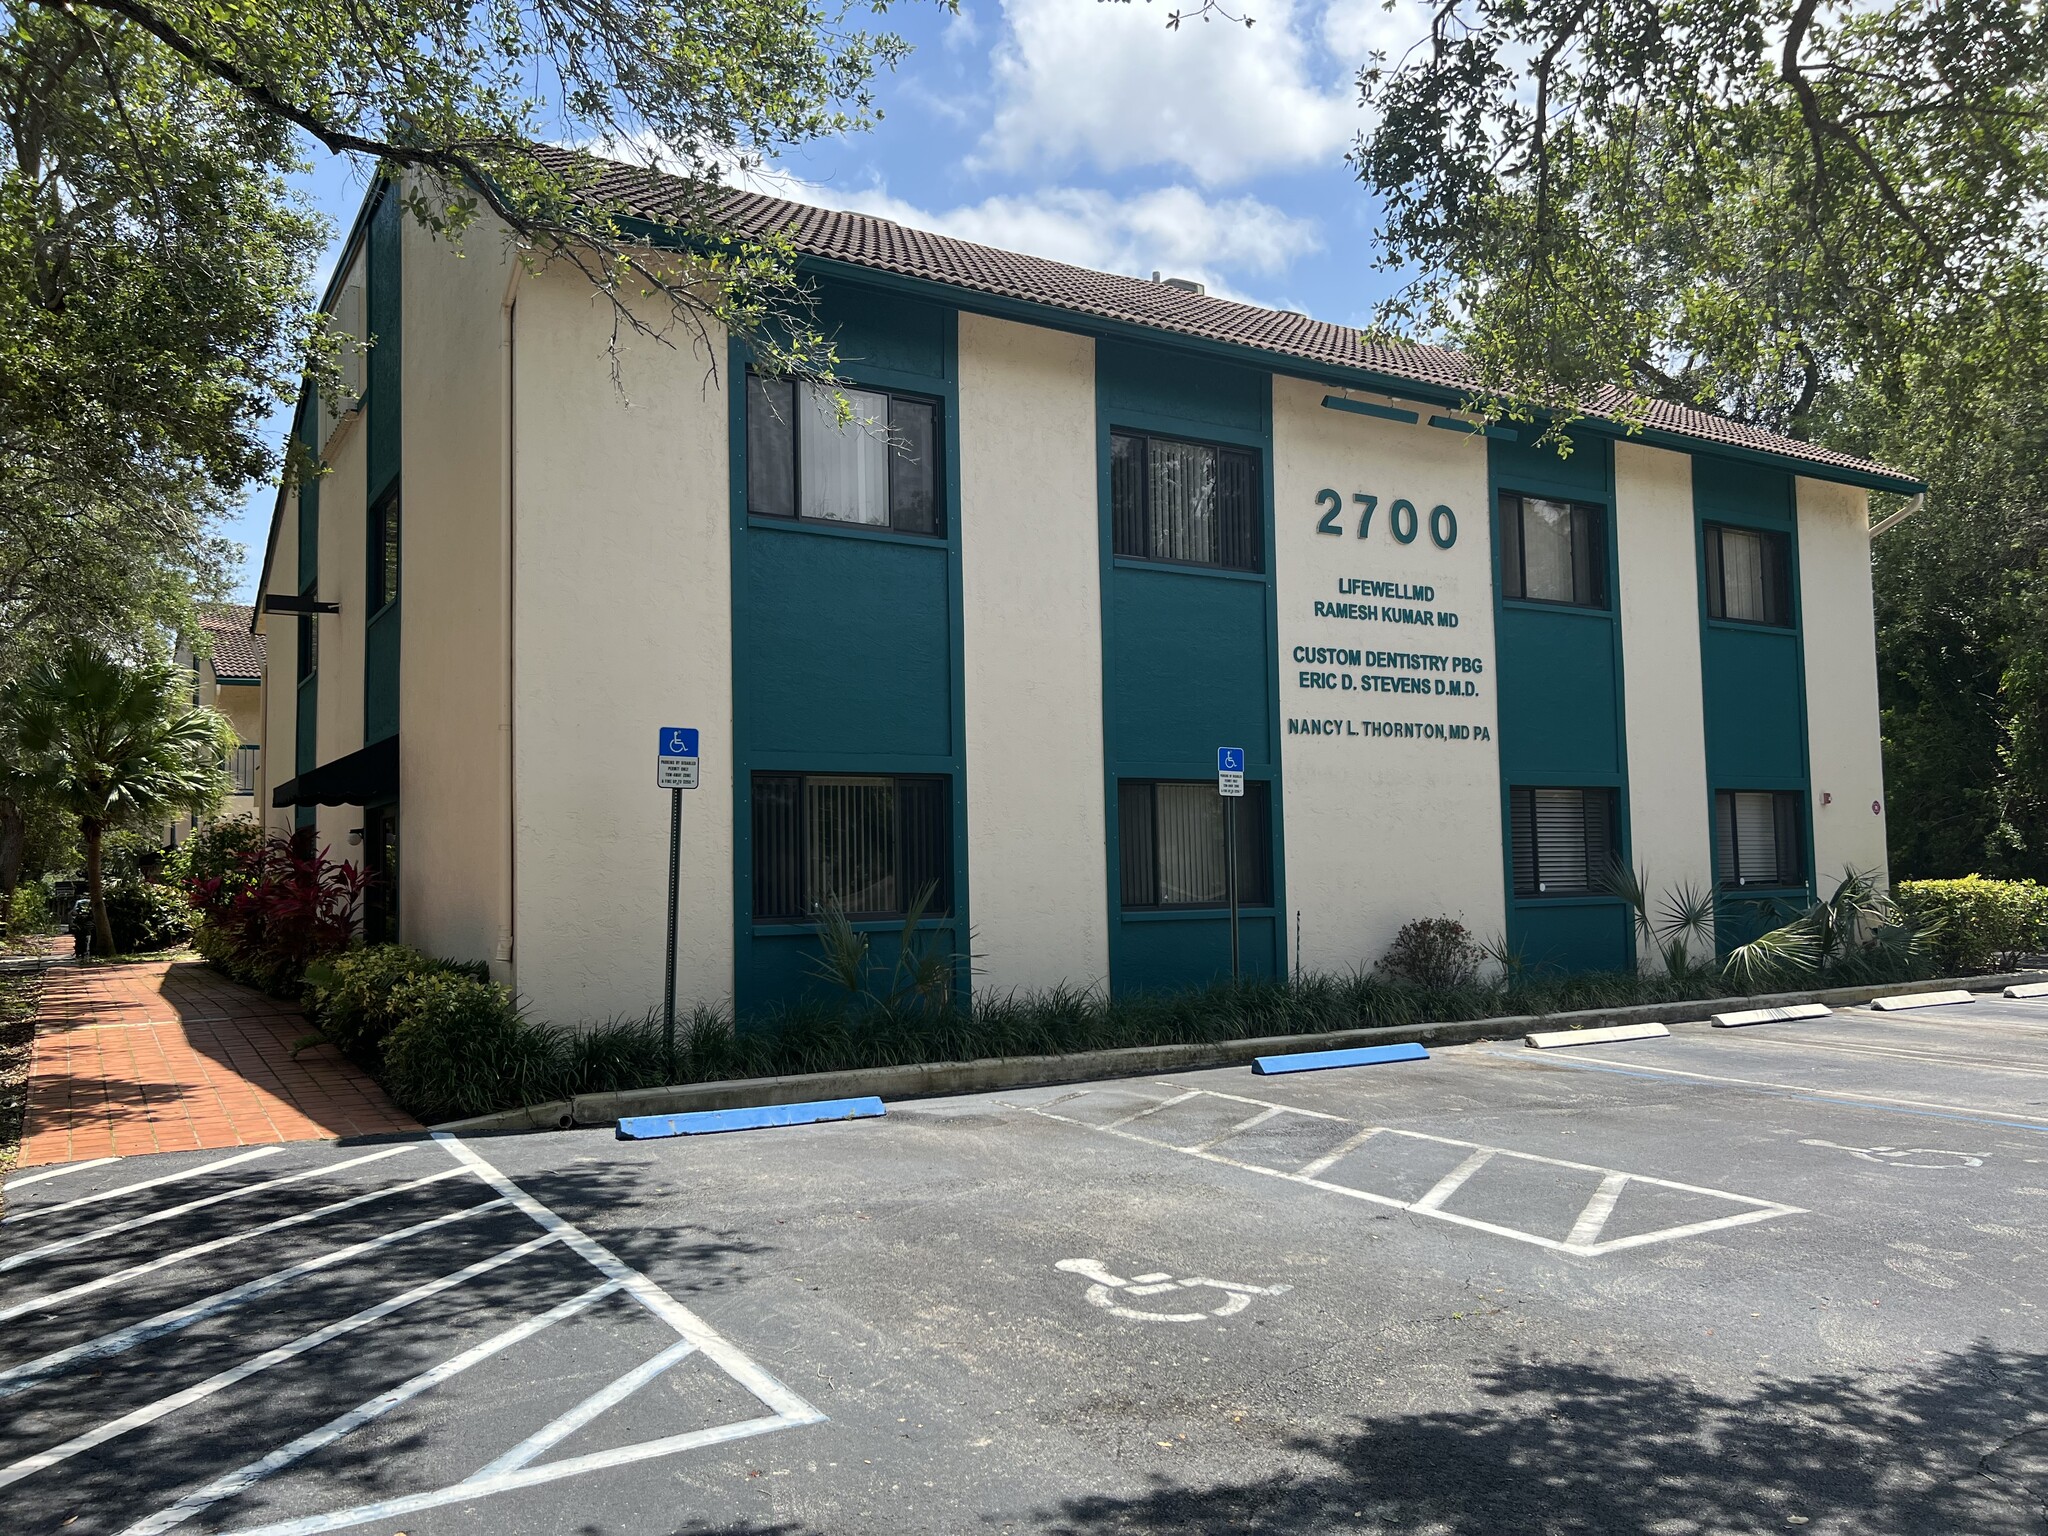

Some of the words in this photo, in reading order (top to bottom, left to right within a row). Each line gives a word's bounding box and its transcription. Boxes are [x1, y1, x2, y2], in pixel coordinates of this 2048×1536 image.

[1315, 488, 1458, 550] 2700
[1338, 577, 1434, 602] LIFEWELLMD
[1314, 601, 1378, 621] RAMESH
[1381, 606, 1434, 627] KUMAR
[1437, 612, 1459, 628] MD
[1293, 646, 1361, 666] CUSTOM
[1365, 650, 1448, 672] DENTISTRY
[1452, 656, 1483, 674] PBG
[1299, 671, 1337, 689] ERIC
[1341, 674, 1357, 691] D.
[1361, 675, 1431, 695] STEVENS
[1435, 679, 1479, 697] D.M.D.
[1288, 718, 1343, 736] NANCY
[1347, 720, 1359, 736] L.
[1473, 726, 1490, 742] PA
